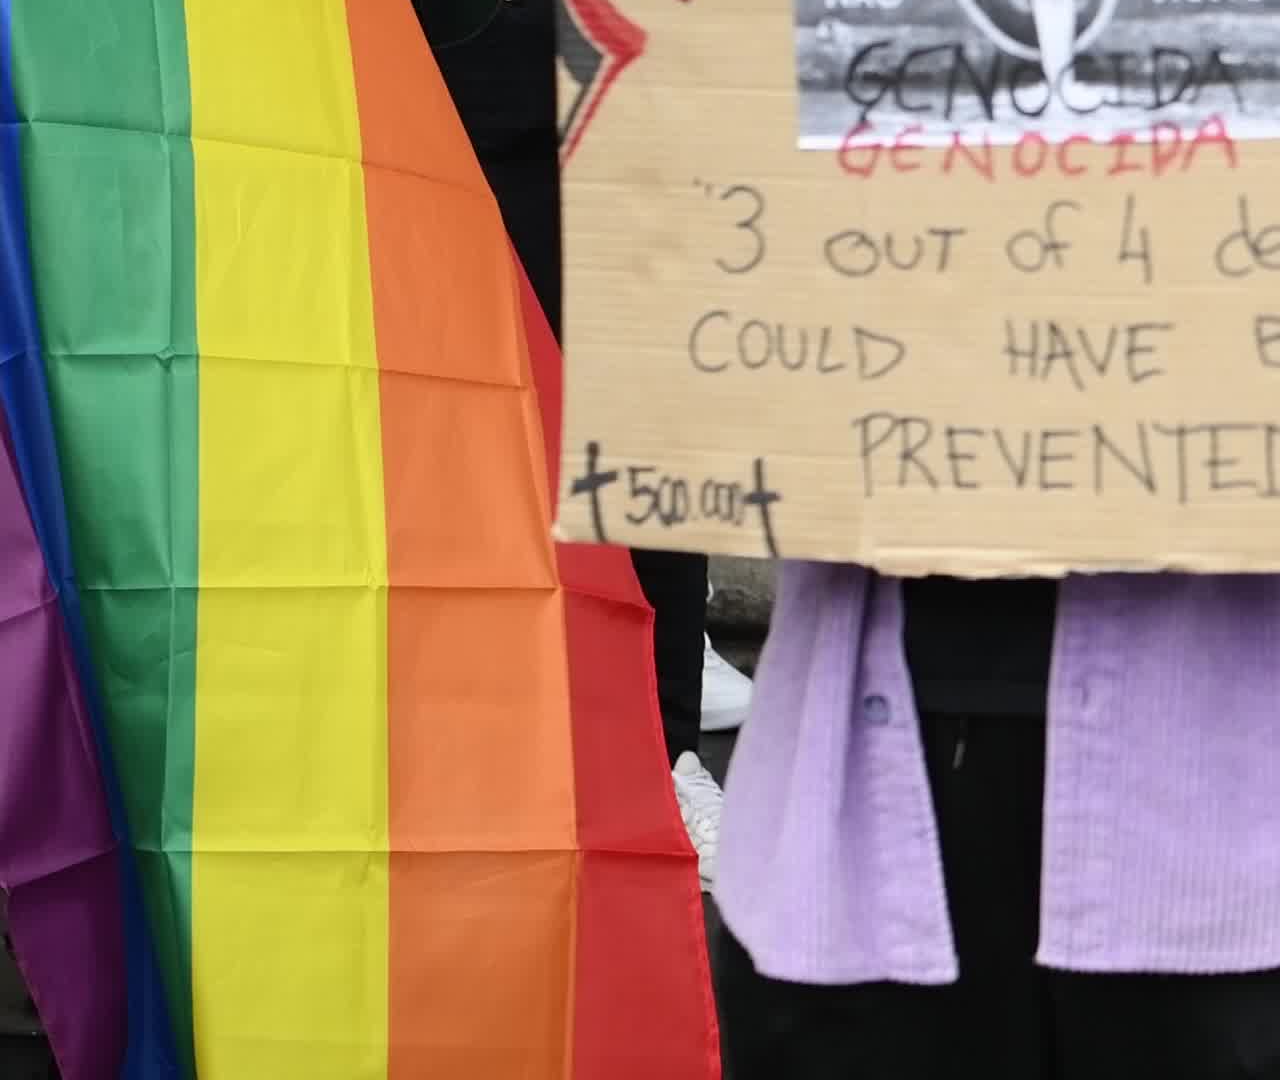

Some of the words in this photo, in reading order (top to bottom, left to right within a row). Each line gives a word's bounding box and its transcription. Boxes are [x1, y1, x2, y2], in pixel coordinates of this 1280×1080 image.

[844, 41, 1247, 121] GENOCIDA
[837, 114, 1239, 176] GENOCIDA
[823, 224, 968, 275] OUT
[1118, 196, 1151, 279] 4
[689, 309, 908, 381] COULD
[1003, 319, 1175, 388] HAVE
